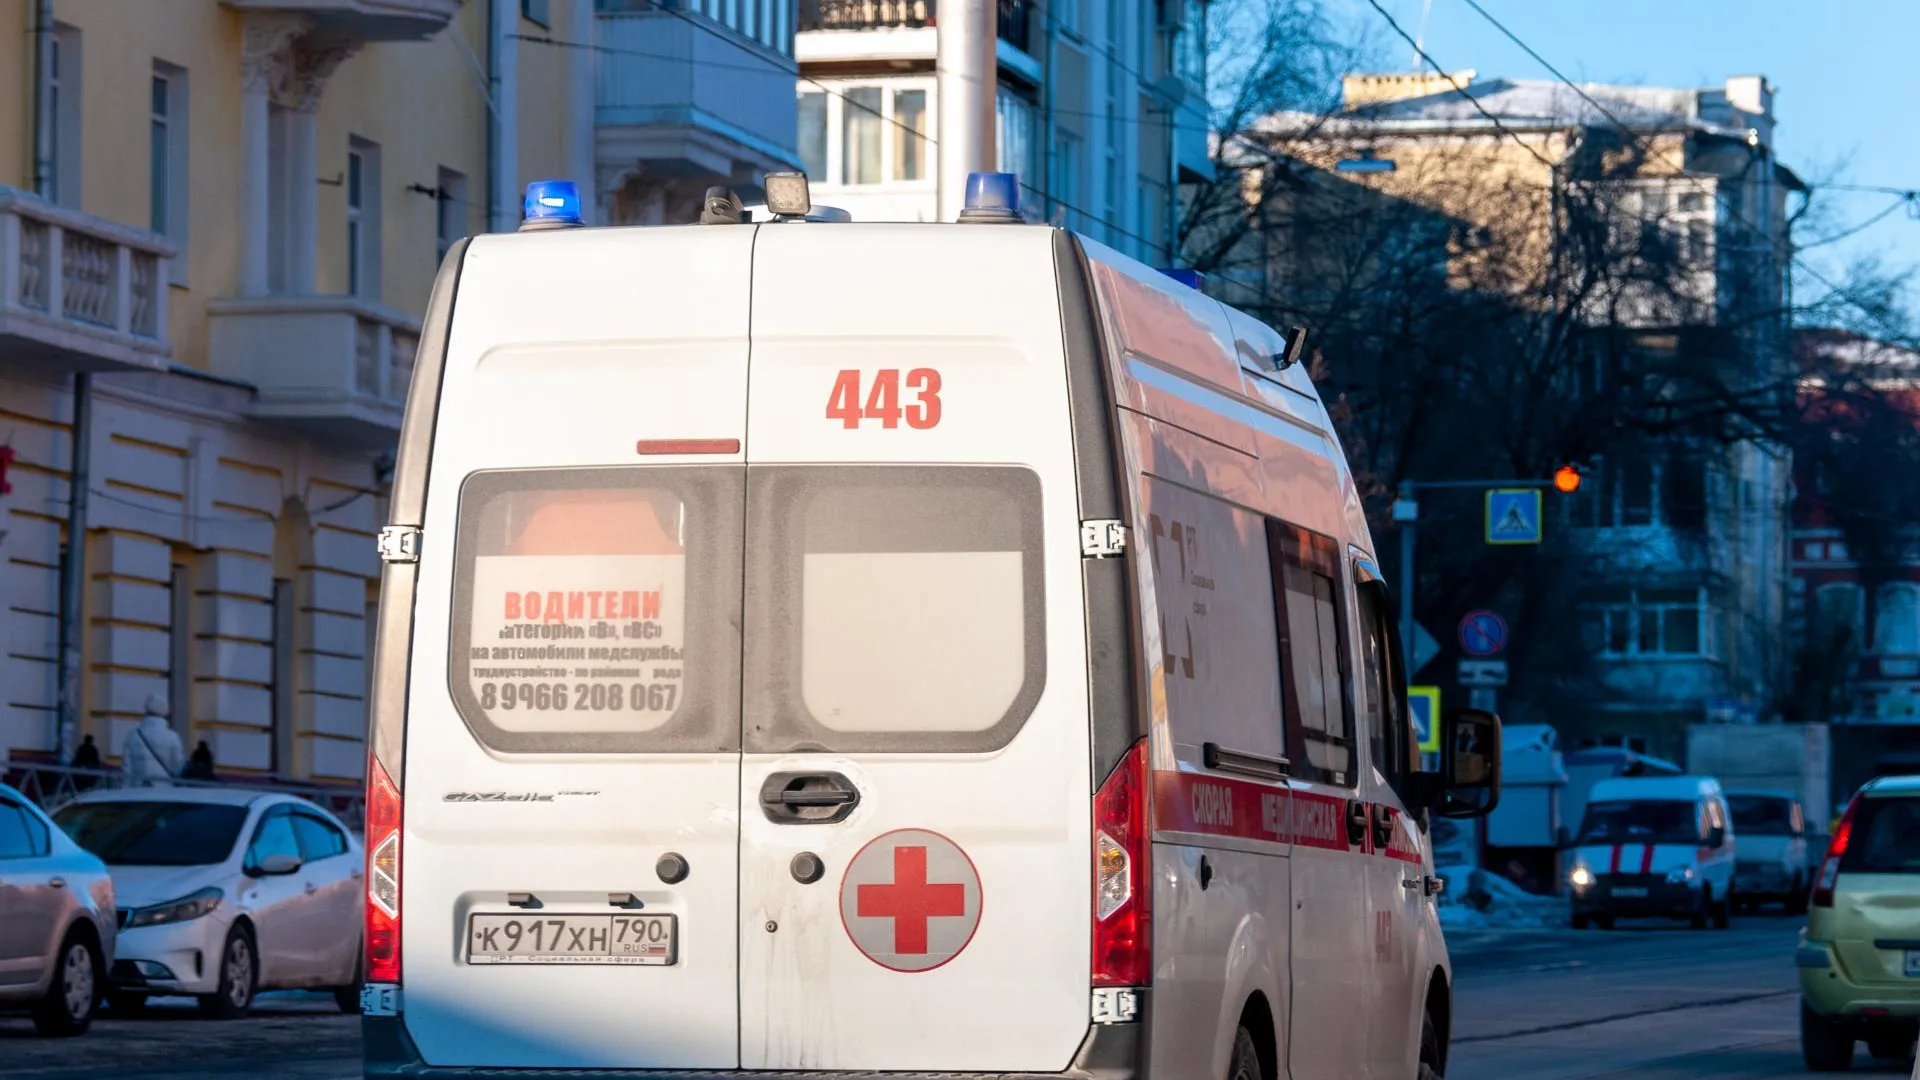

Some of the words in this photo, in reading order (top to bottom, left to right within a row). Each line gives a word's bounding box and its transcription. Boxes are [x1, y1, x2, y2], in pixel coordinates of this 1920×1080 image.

[826, 367, 942, 430] 443
[504, 590, 661, 623] ВОДИТЕЛИ
[470, 646, 489, 660] на
[492, 644, 585, 660] автомобили
[588, 645, 684, 662] медслужбы
[574, 683, 623, 711] 208
[630, 683, 677, 711] 067
[1192, 782, 1233, 827] СКОРАЯ
[614, 919, 664, 943] 790
[623, 944, 648, 953] RUS
